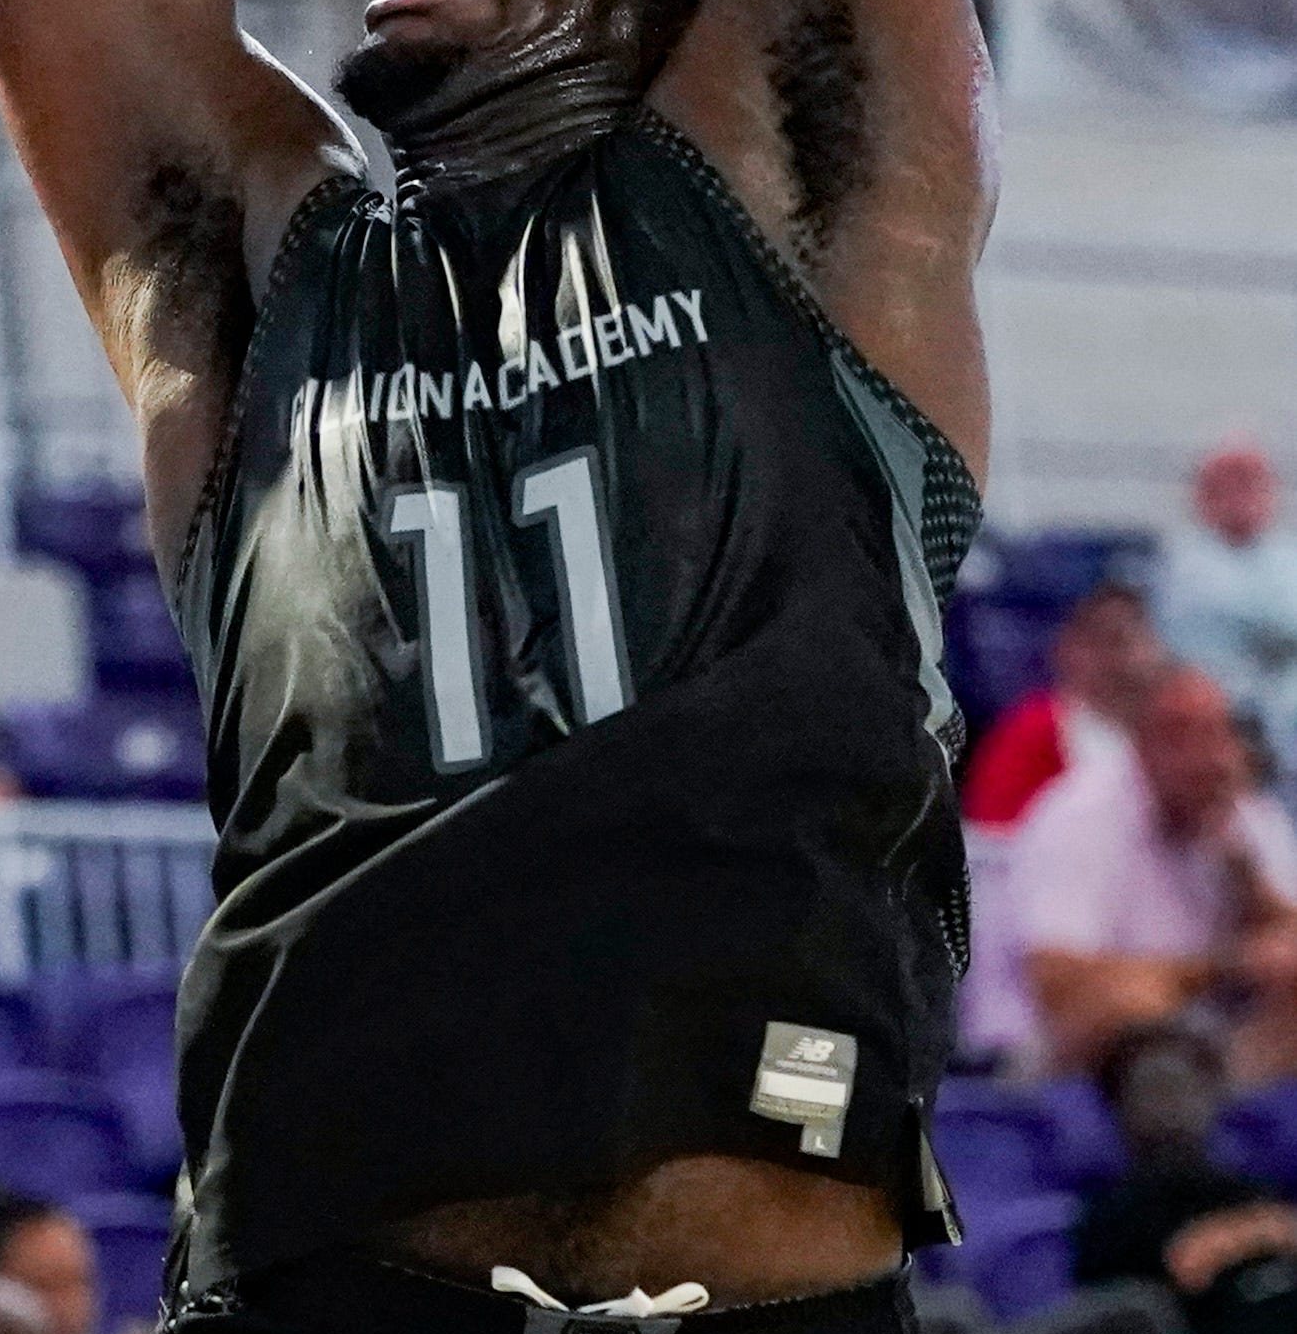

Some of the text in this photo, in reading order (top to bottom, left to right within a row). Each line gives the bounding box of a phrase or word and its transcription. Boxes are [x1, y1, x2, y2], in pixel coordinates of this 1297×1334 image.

[461, 288, 708, 412] ACADEMY
[387, 447, 634, 771] 11
[815, 1135, 828, 1151] L
